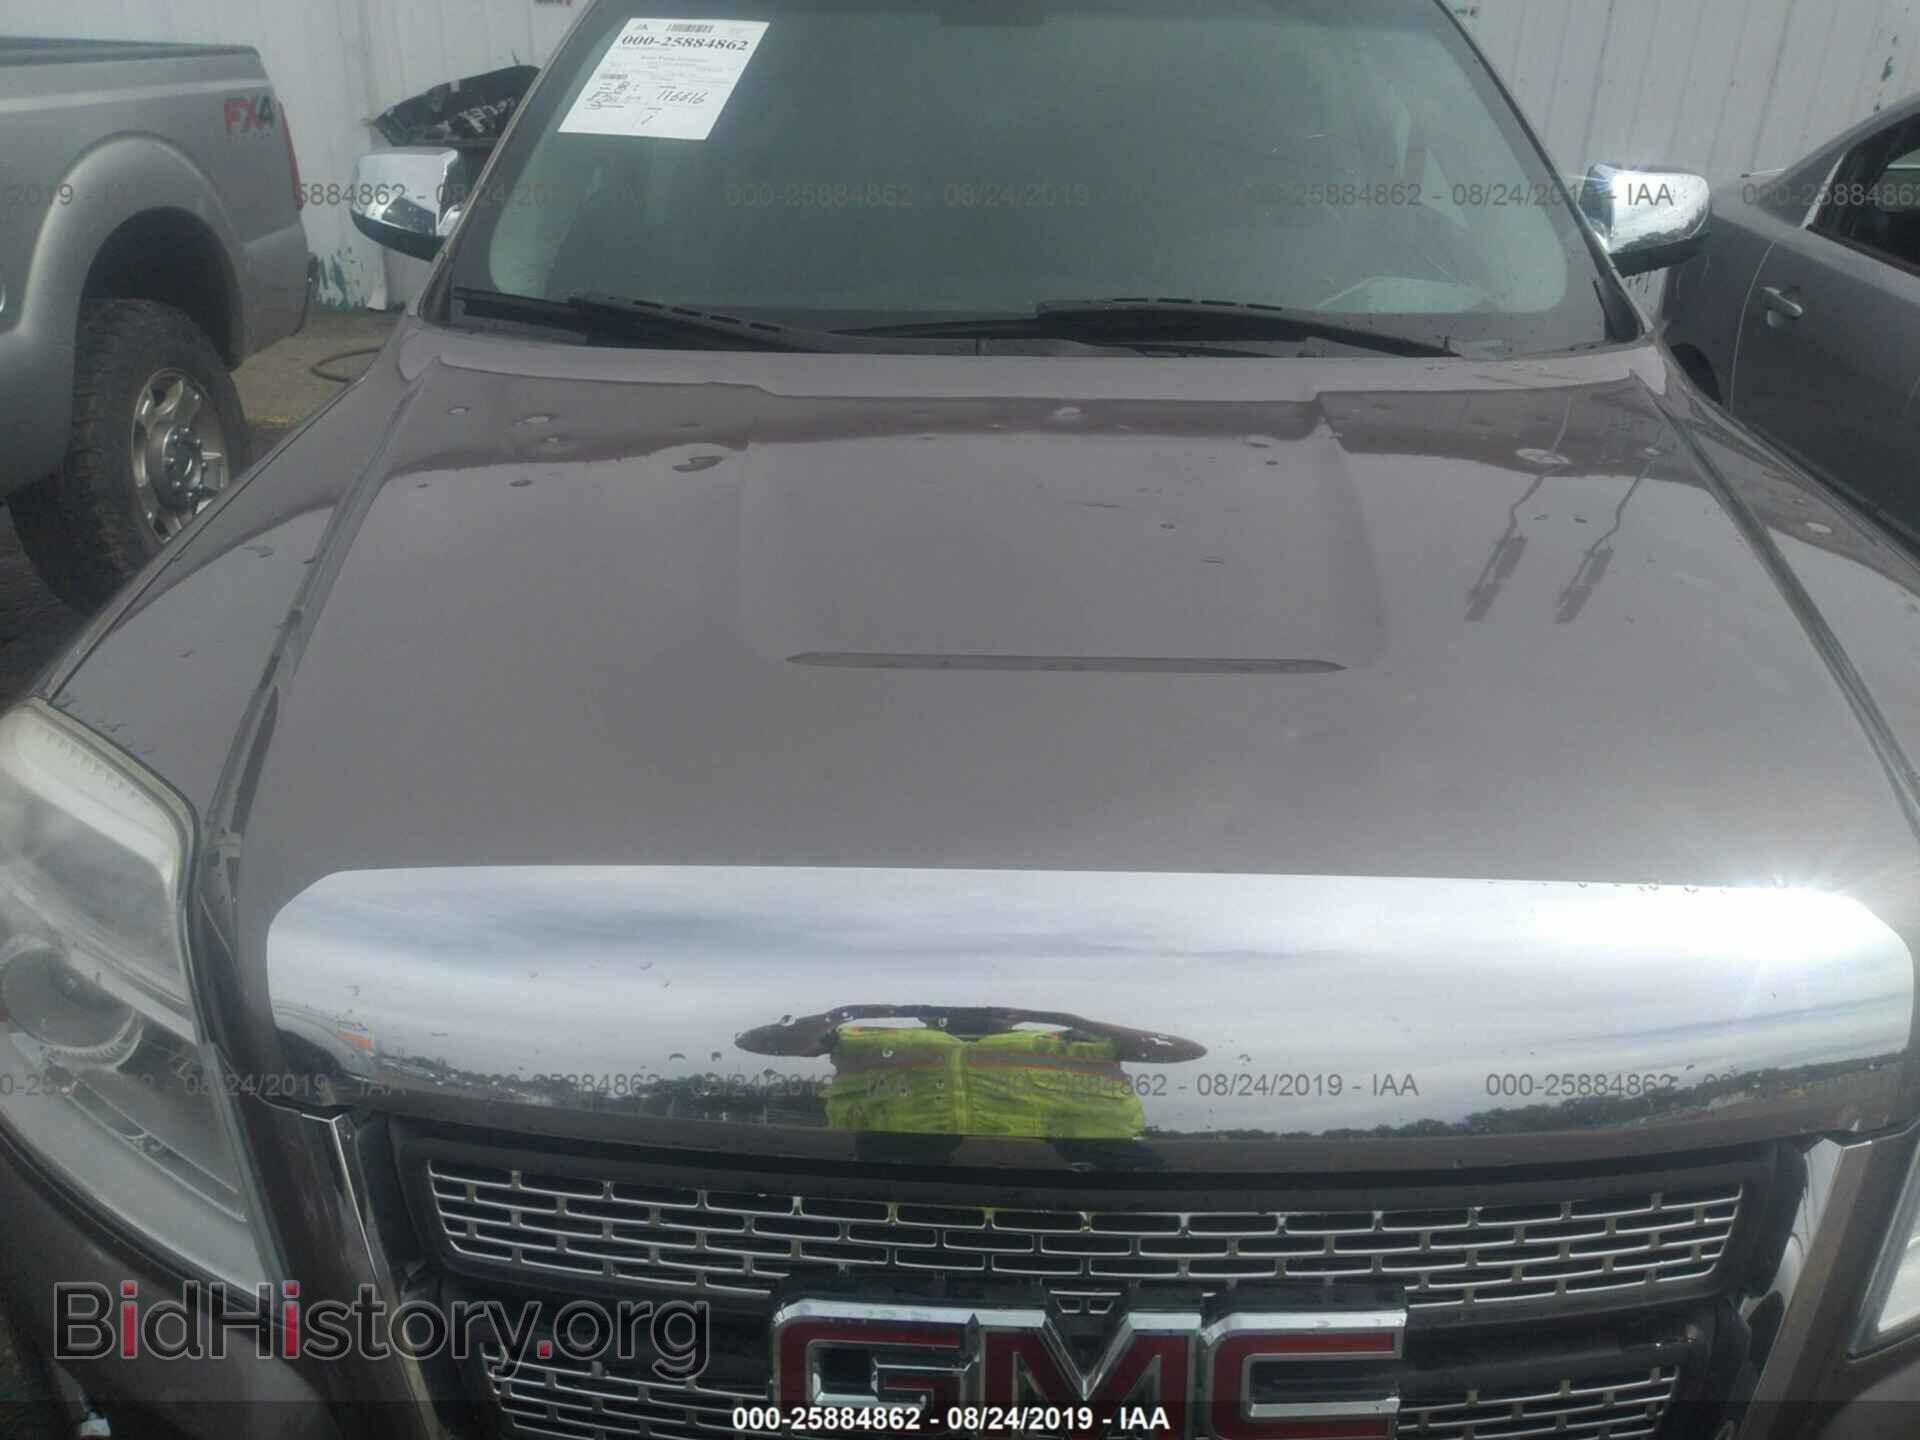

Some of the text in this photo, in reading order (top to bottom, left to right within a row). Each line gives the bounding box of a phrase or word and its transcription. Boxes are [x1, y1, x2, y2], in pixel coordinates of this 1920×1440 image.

[621, 35, 749, 51] 000-25884862
[223, 96, 274, 132] FX4
[770, 1299, 1408, 1440] GMC
